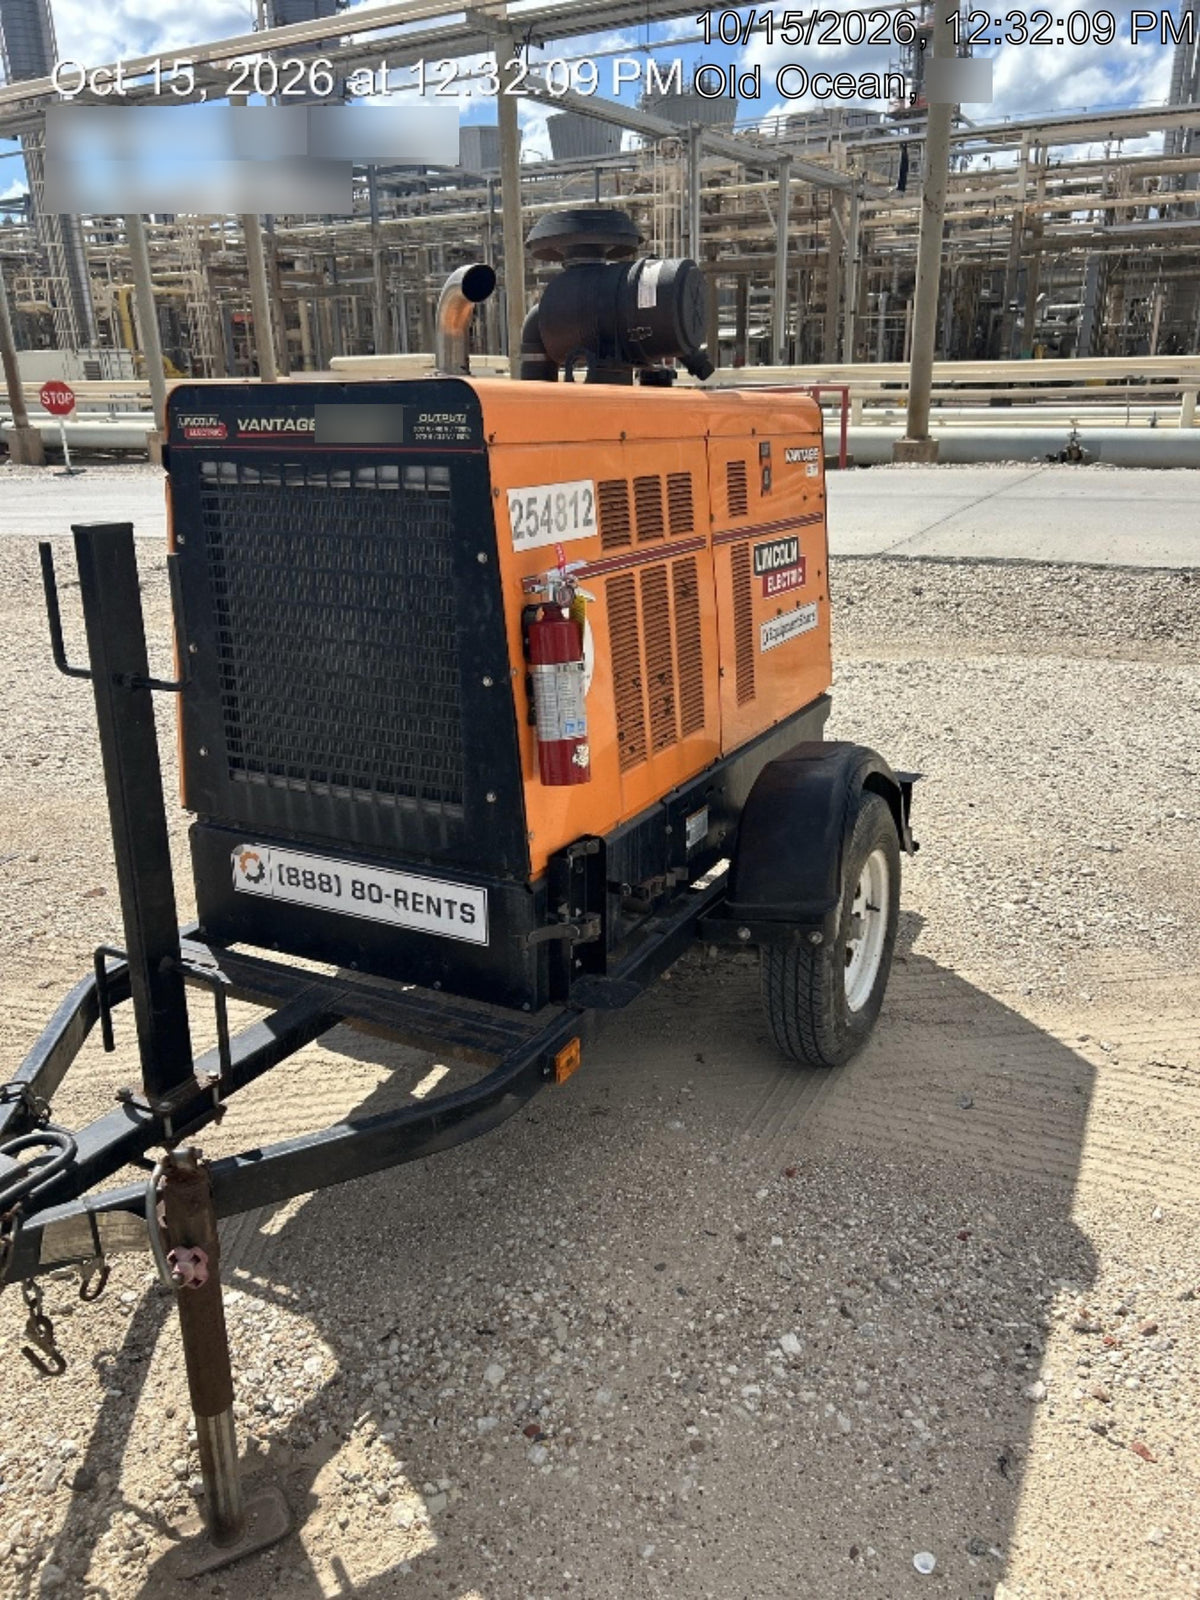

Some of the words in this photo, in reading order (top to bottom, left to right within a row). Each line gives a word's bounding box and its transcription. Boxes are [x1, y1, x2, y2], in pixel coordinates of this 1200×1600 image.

[41, 391, 74, 405] STOP
[510, 489, 594, 539] 254812
[755, 541, 797, 571] LINCOLN
[768, 568, 803, 592] ELECTRIC
[277, 863, 342, 896] (888)
